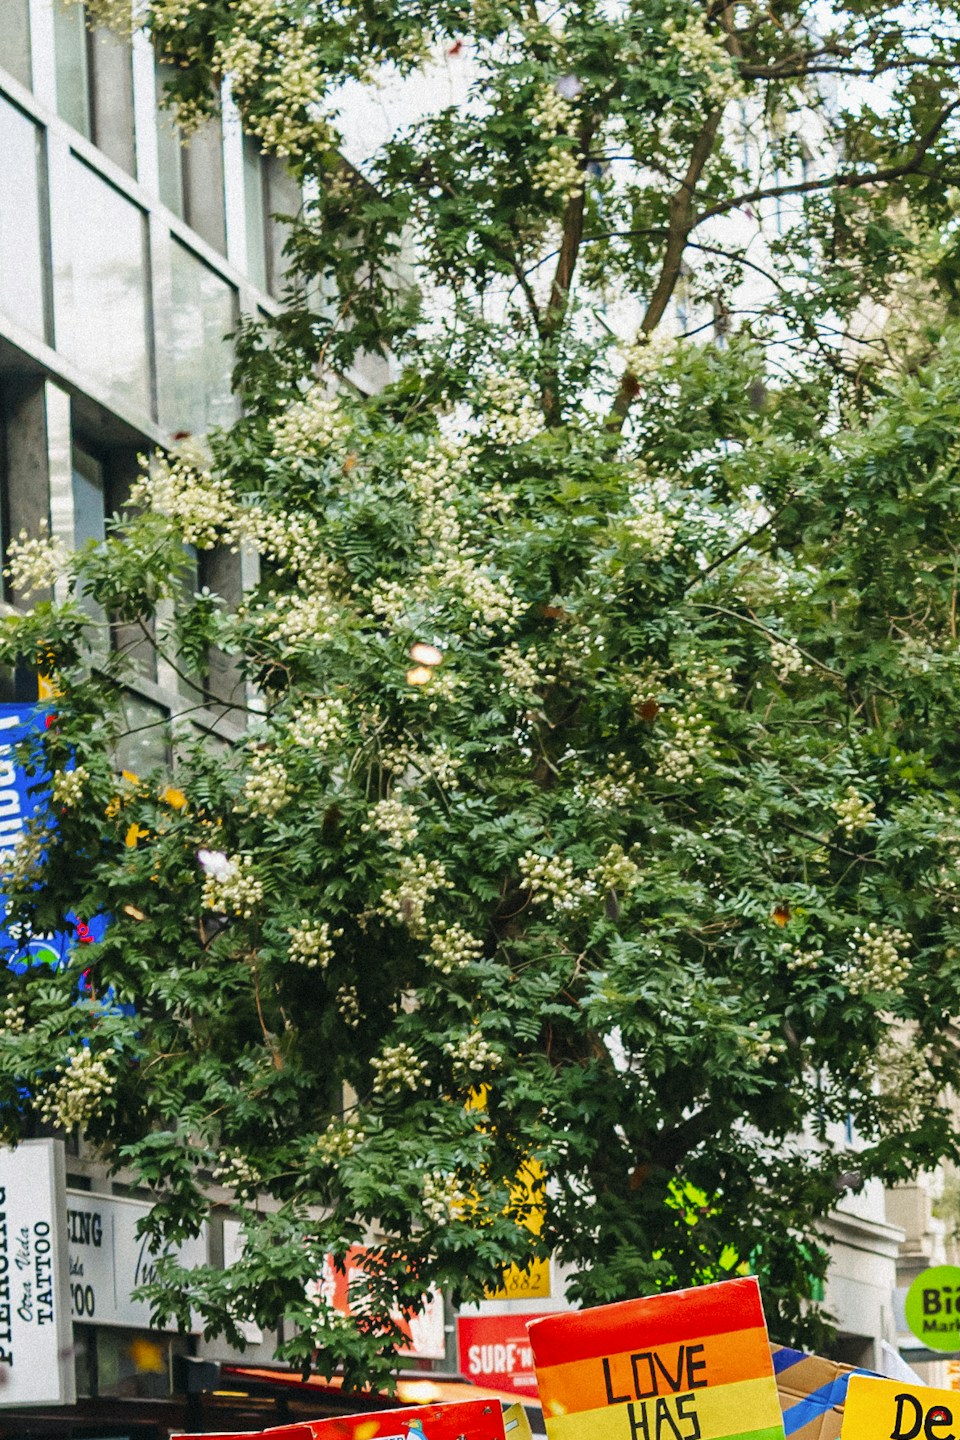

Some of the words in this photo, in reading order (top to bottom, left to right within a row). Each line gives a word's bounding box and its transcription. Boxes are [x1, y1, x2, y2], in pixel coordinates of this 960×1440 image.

[68, 1211, 102, 1248] ING
[34, 1221, 53, 1325] TATTOO
[508, 1273, 541, 1291] 882
[602, 1344, 708, 1405] LOVE
